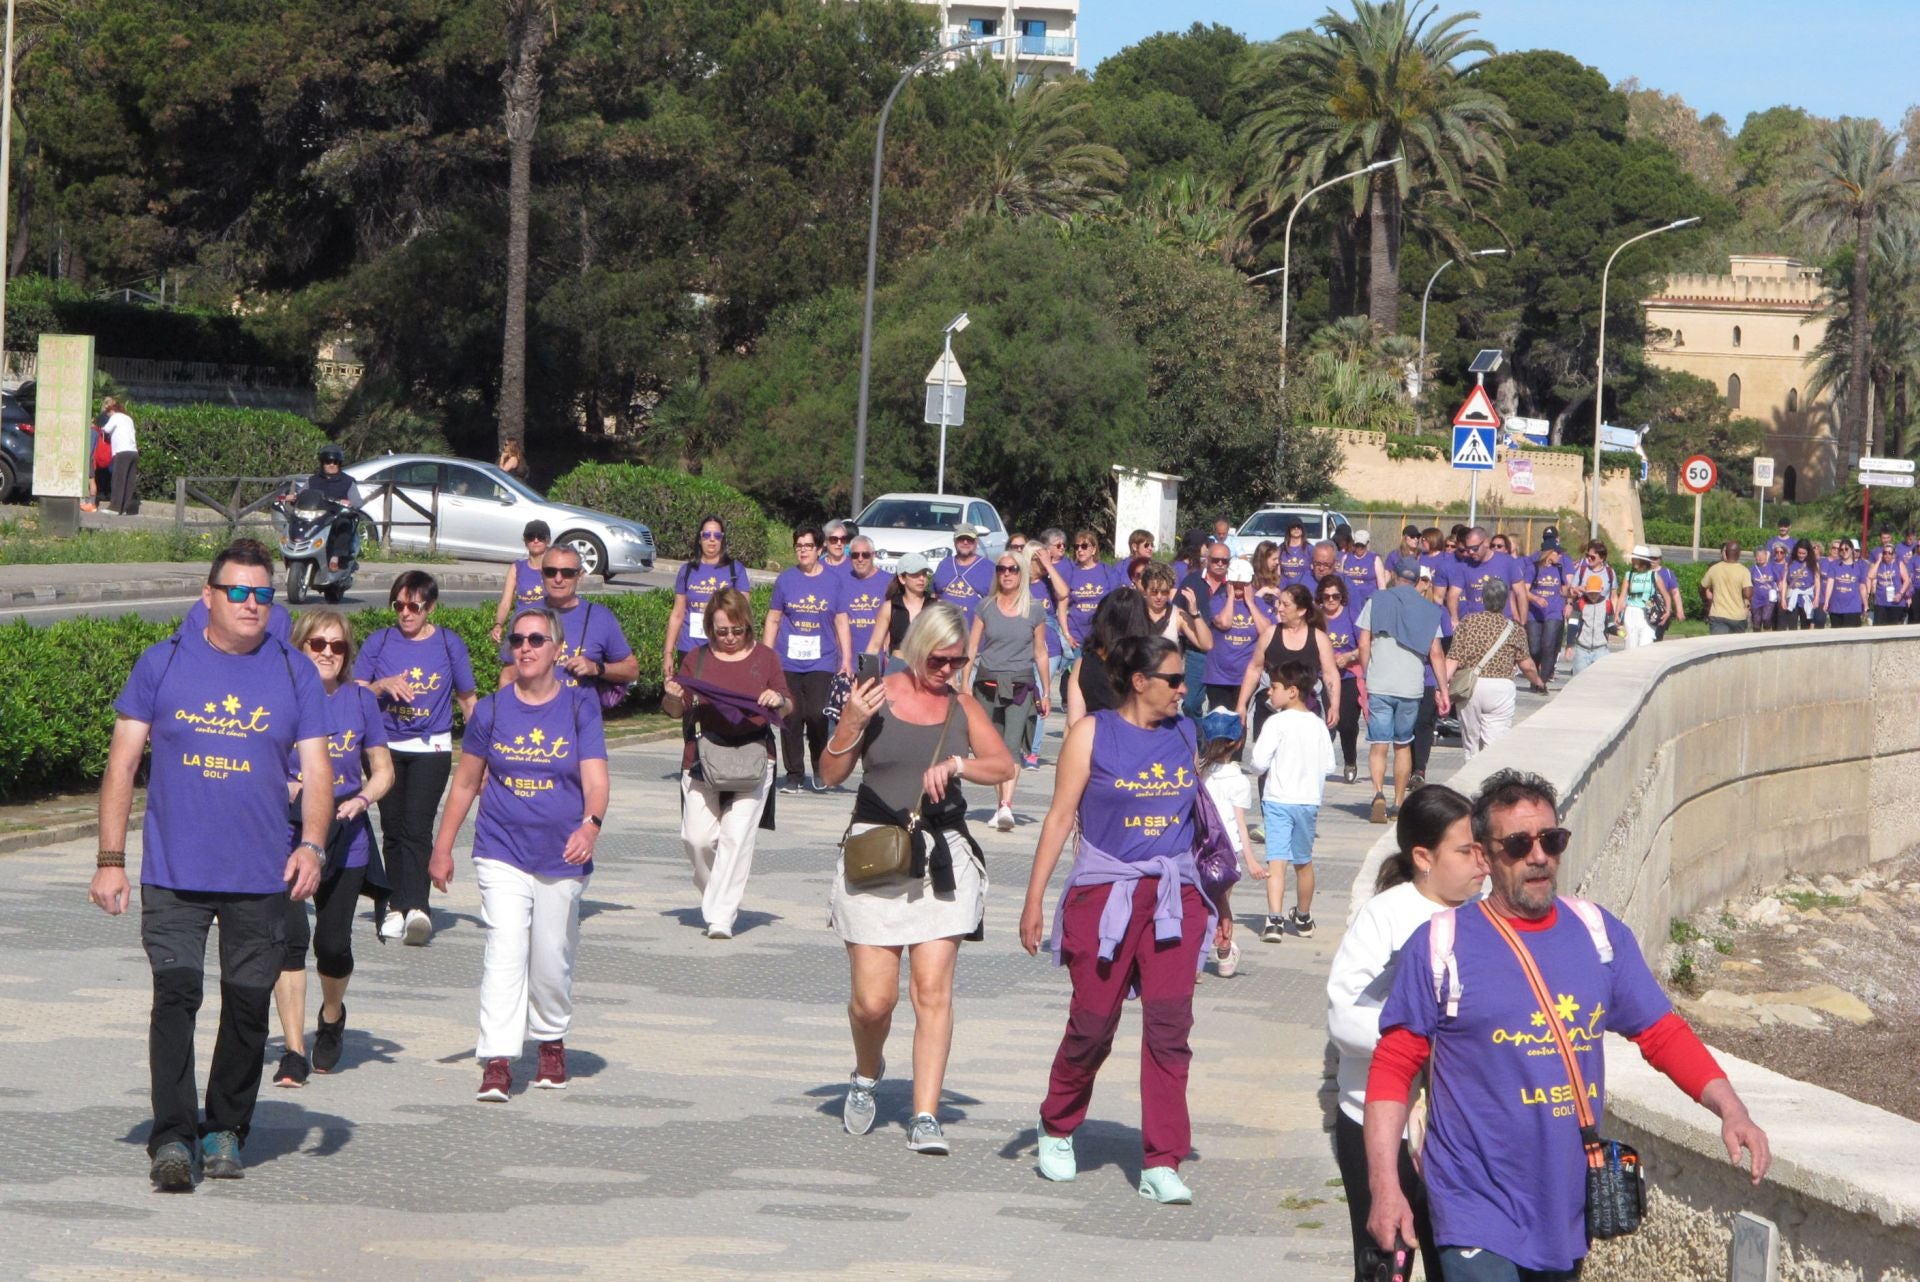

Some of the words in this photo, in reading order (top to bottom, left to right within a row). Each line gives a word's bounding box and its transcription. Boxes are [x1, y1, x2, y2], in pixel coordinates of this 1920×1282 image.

[1689, 467, 1709, 480] 50
[175, 706, 271, 731] amunt
[493, 736, 569, 758] amunt
[183, 753, 201, 766] LA
[204, 755, 251, 772] SELLA
[203, 769, 229, 780] GOLF
[1114, 766, 1194, 791] amunt
[515, 779, 554, 790] SELLA
[514, 789, 536, 798] GOLF
[1124, 816, 1141, 827] LA
[1144, 815, 1180, 827] SELA
[1520, 1087, 1548, 1104] LA
[1550, 1082, 1598, 1103] SELA
[1552, 1104, 1576, 1117] GOLF
